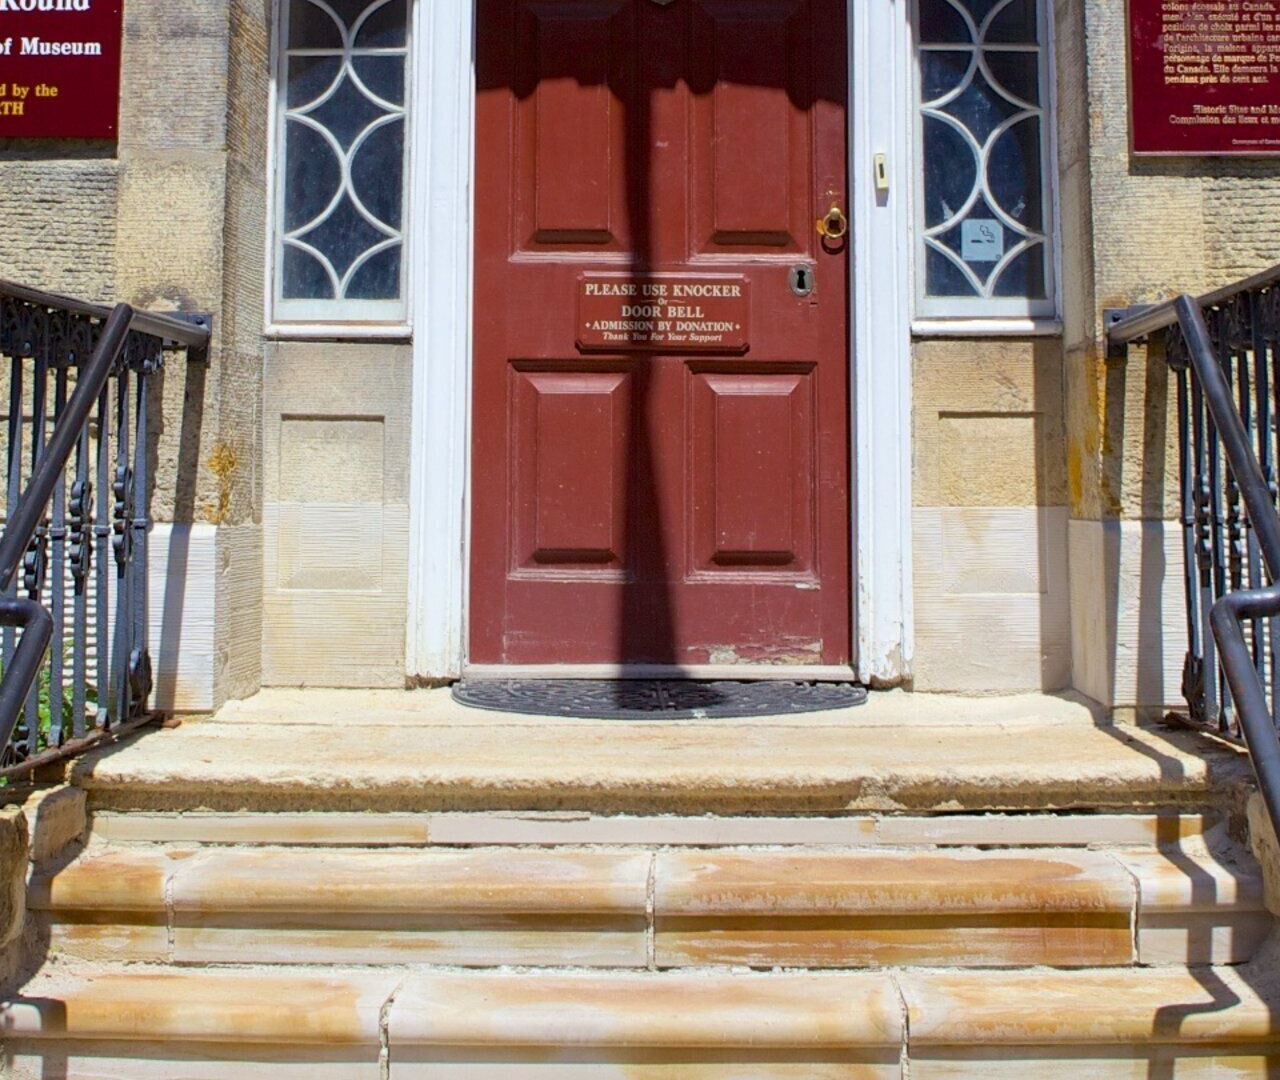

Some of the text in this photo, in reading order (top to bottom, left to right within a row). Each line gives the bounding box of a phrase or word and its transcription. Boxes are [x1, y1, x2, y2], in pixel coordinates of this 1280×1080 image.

[20, 37, 101, 55] Museum
[13, 84, 26, 98] by
[36, 84, 57, 96] the
[586, 285, 741, 296] PLEASE USE KNOCKER
[622, 306, 704, 318] DOOR BELL
[592, 321, 733, 331] ADMISSION BY DONATION
[668, 333, 686, 341] Your
[689, 333, 721, 342] Support
